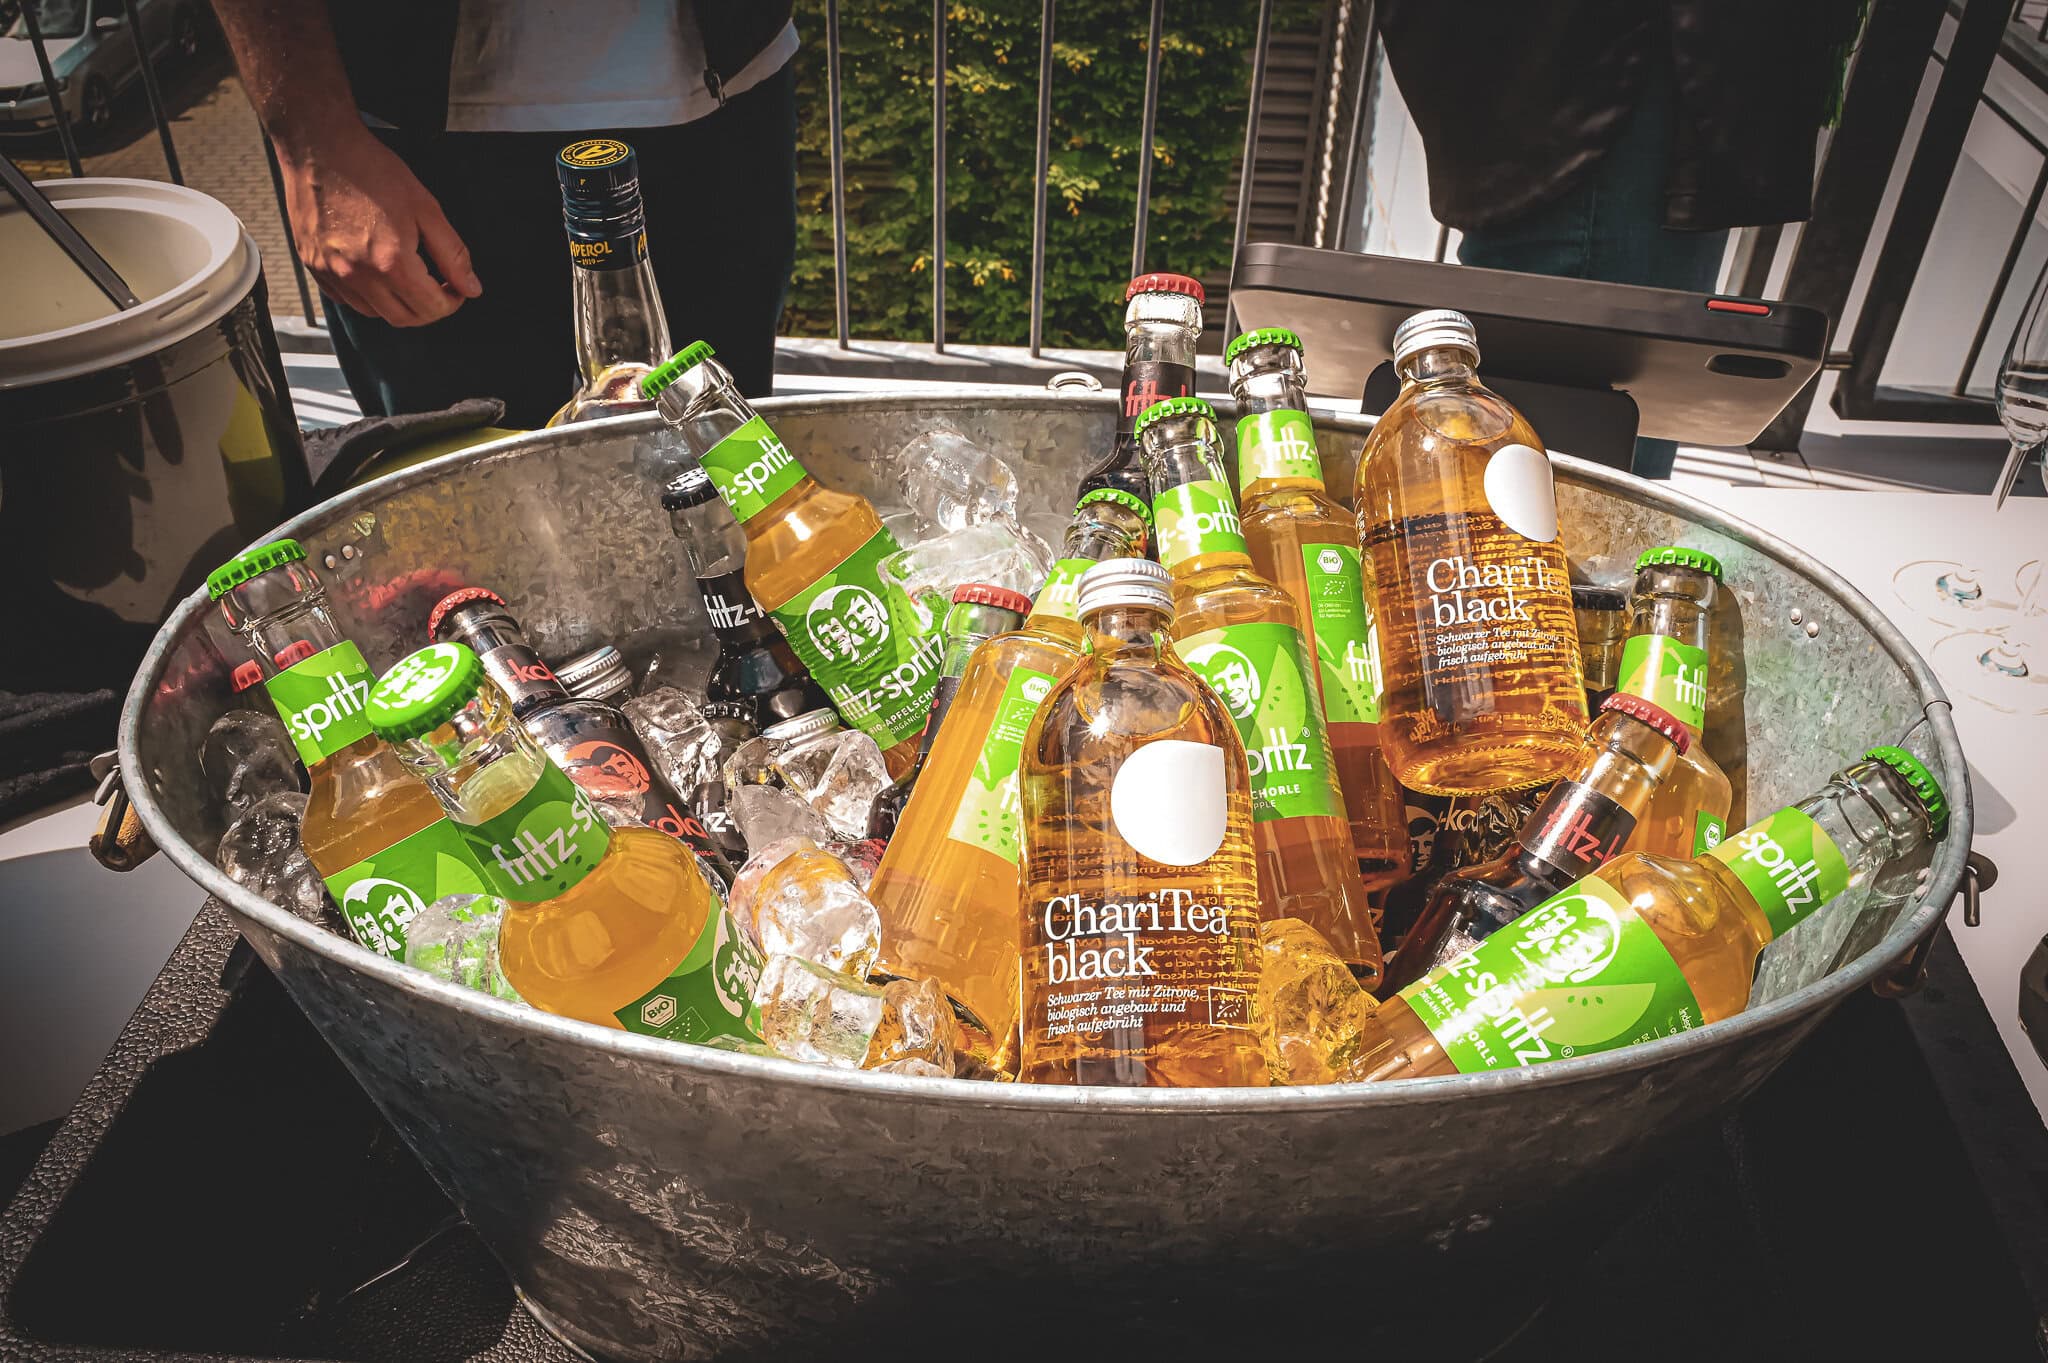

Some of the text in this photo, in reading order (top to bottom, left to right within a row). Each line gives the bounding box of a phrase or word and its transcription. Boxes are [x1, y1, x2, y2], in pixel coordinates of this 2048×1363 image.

[570, 240, 613, 257] APEROL
[1429, 587, 1533, 628] black
[1436, 629, 1491, 645] Schwarzer
[1493, 627, 1511, 638] Tee
[1512, 628, 1529, 638] mit
[1437, 640, 1489, 657] biologisch
[1491, 638, 1537, 652] angebaut
[1438, 653, 1468, 670] frisch
[890, 712, 921, 735] ORGANIC
[1044, 889, 1231, 940] ChariTea
[1046, 932, 1157, 985] black
[1047, 984, 1200, 1007] Schwarzer Tee mit Zitrone,
[1047, 1001, 1186, 1022] biologisch angebaut und
[1047, 1016, 1144, 1039] frisch aufgebrüht
